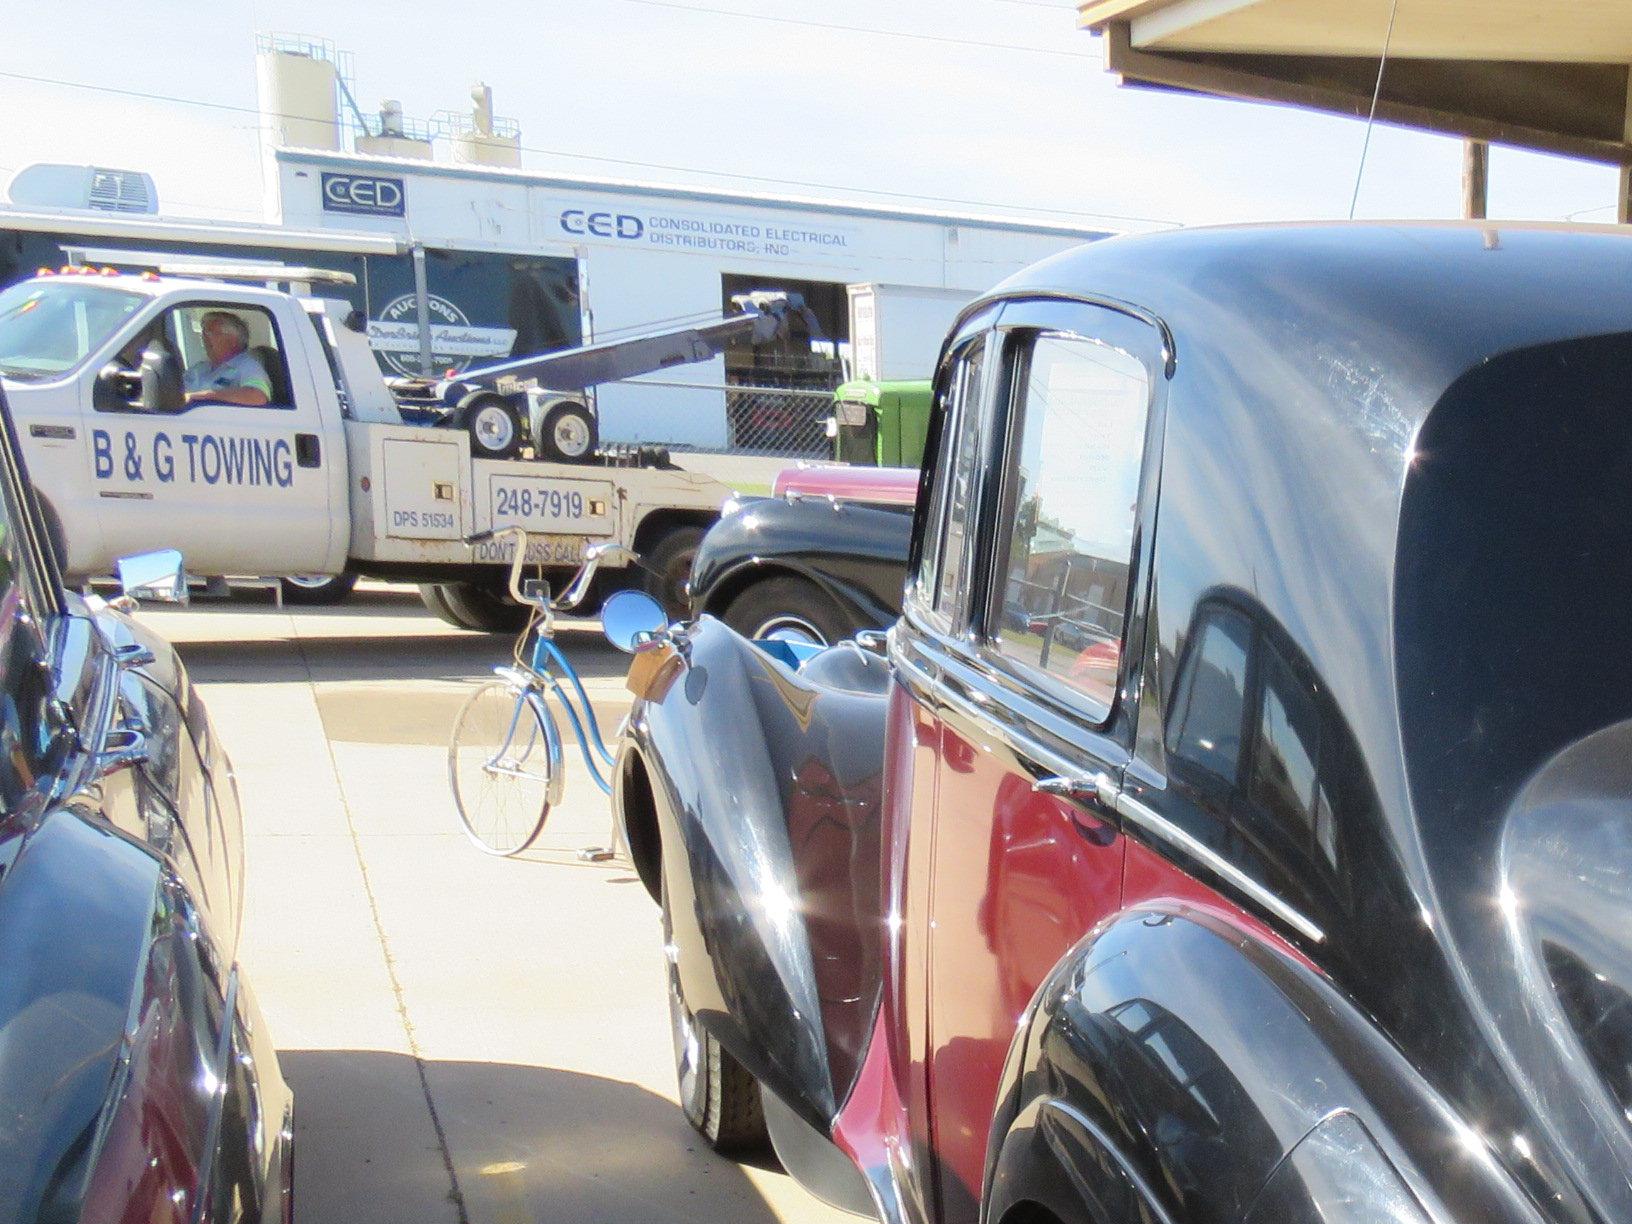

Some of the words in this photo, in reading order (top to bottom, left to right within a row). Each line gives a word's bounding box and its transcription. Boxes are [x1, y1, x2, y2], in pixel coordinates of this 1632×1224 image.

[325, 177, 401, 207] CED
[560, 209, 644, 240] CED
[649, 216, 760, 239] CONSOLIDATED
[765, 228, 848, 247] ELECTRICAL
[390, 298, 459, 323] AUCONS
[92, 429, 113, 479] B
[124, 431, 144, 481] &
[153, 431, 174, 482] G
[181, 434, 293, 487] TOWING
[497, 488, 583, 519] 248-7919
[393, 511, 418, 527] DPS
[422, 513, 454, 528] 51534
[522, 543, 552, 560] USS
